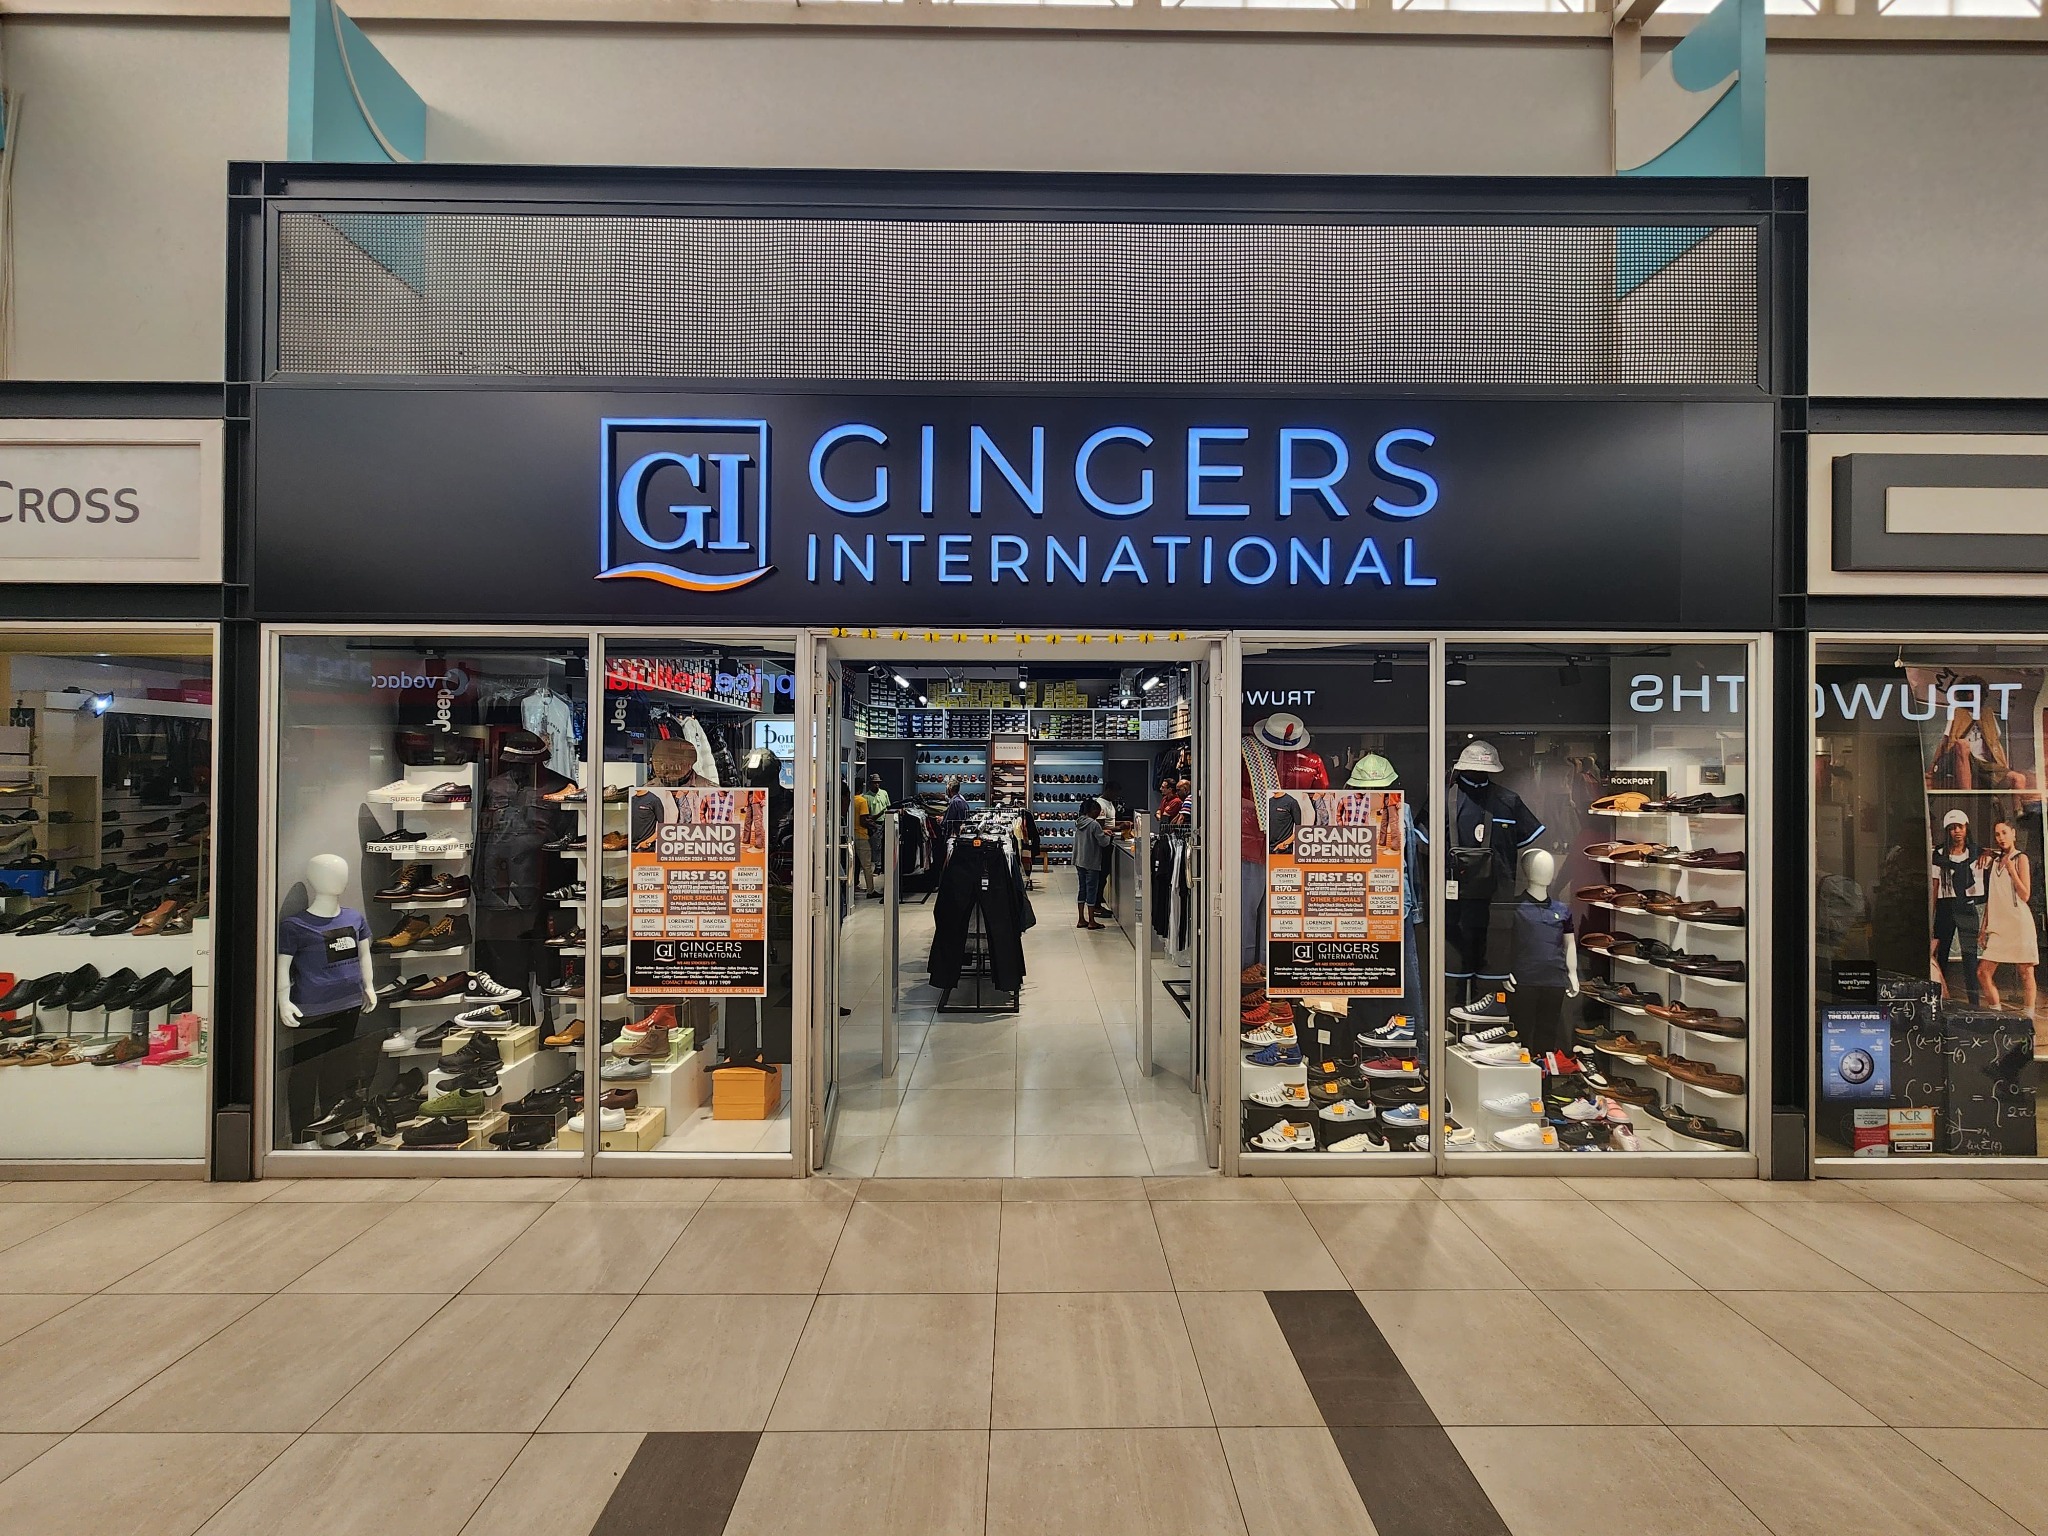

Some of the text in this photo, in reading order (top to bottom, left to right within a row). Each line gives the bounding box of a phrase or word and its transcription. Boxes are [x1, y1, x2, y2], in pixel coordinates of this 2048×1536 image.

[808, 424, 1440, 516] GINGERS
[616, 451, 751, 550] GI
[806, 534, 1438, 587] INTERNATIONAL
[432, 688, 455, 733] Jeep
[610, 697, 628, 731] Jee
[1610, 777, 1655, 786] ROCKPORT
[660, 826, 736, 841] GRAND
[1297, 828, 1372, 843] GRAND
[660, 842, 736, 855] OPENING
[1298, 844, 1372, 857] OPENING
[670, 871, 706, 880] FIRST
[709, 871, 727, 880] 50
[1308, 873, 1343, 882] FIRST
[1346, 873, 1364, 882] 50
[656, 944, 673, 957] GI
[680, 942, 742, 952] GINGERS
[1294, 945, 1311, 959] GI
[1318, 943, 1379, 953] GINGERS
[1838, 979, 1870, 987] MoreTyme
[1900, 1110, 1922, 1121] NCR
